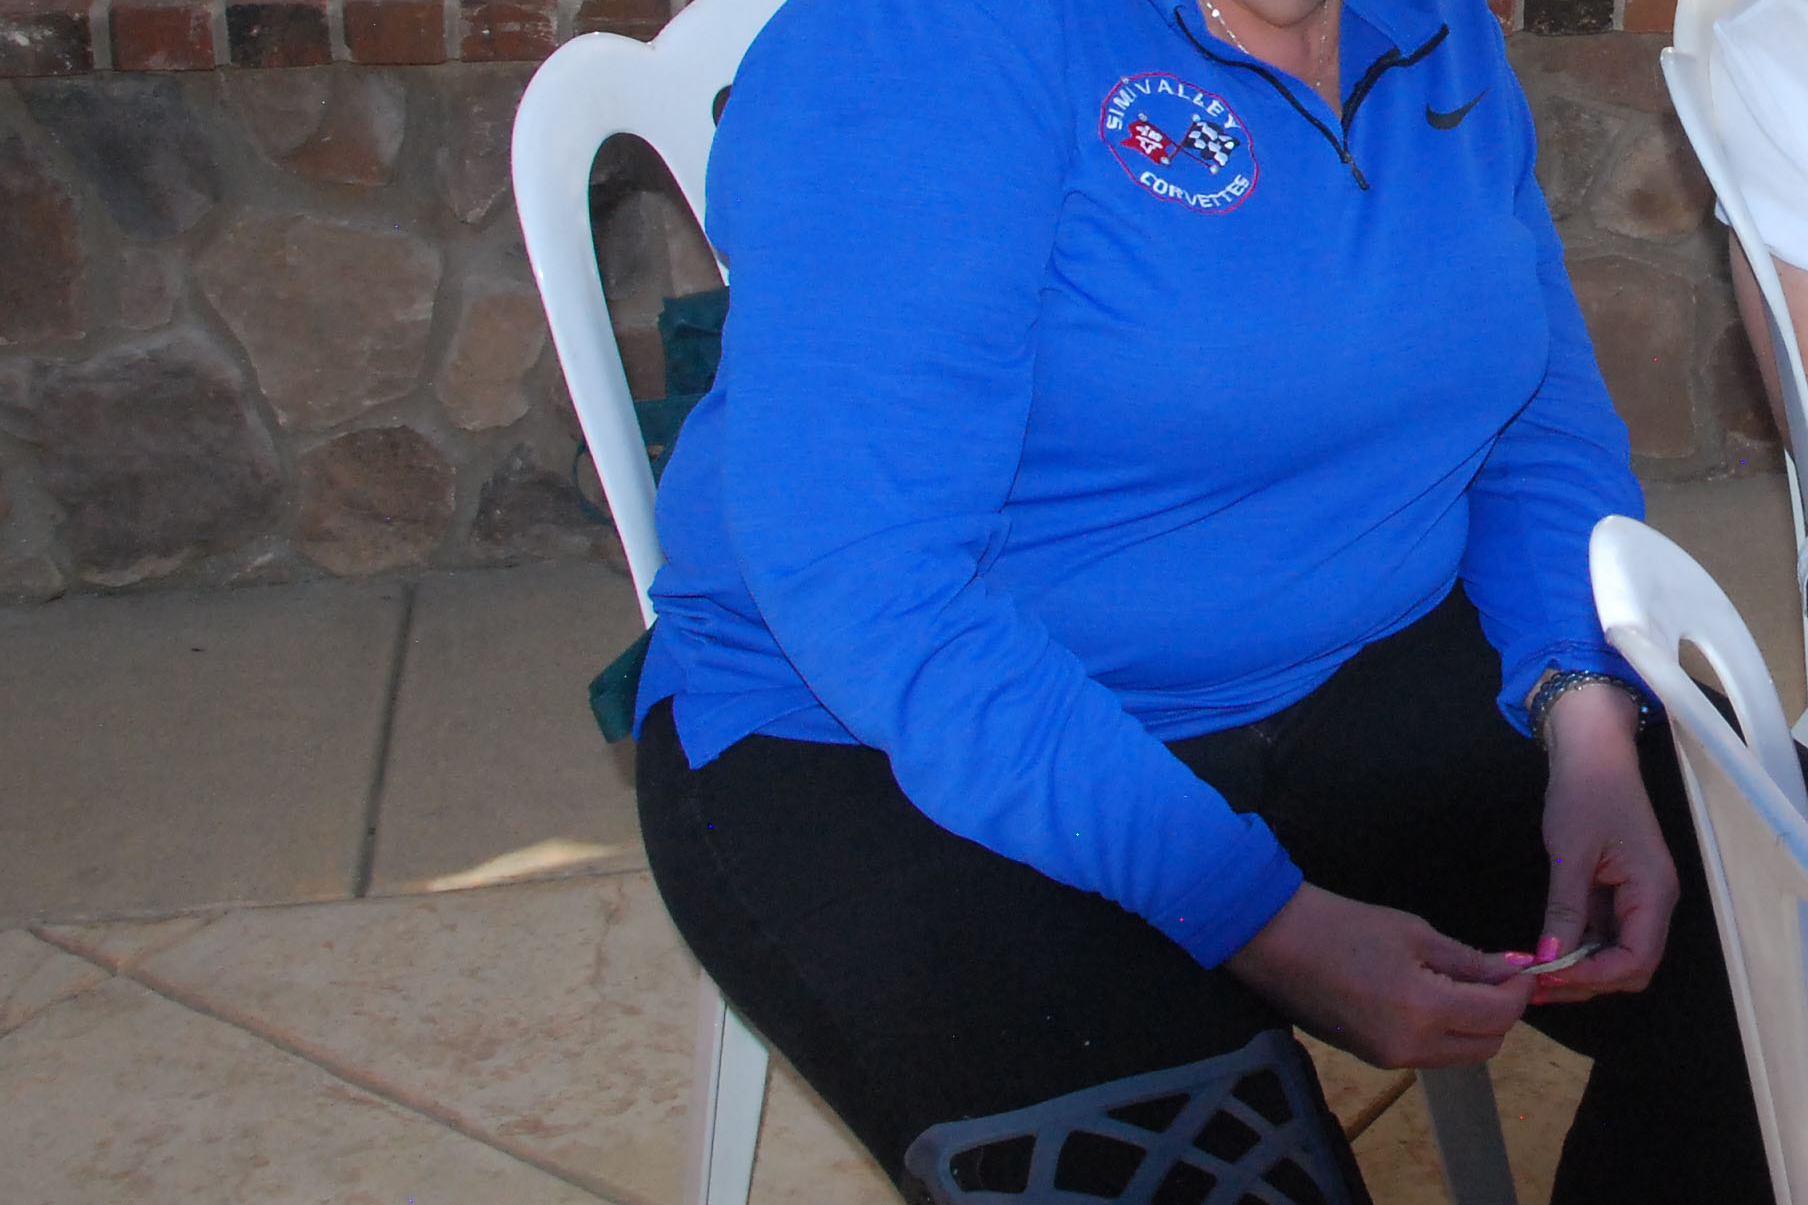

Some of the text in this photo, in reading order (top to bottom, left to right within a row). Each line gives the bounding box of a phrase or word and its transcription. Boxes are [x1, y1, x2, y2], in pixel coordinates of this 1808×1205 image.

[1106, 78, 1242, 130] SIMI VALLEY
[1140, 171, 1250, 209] CORVETTES
